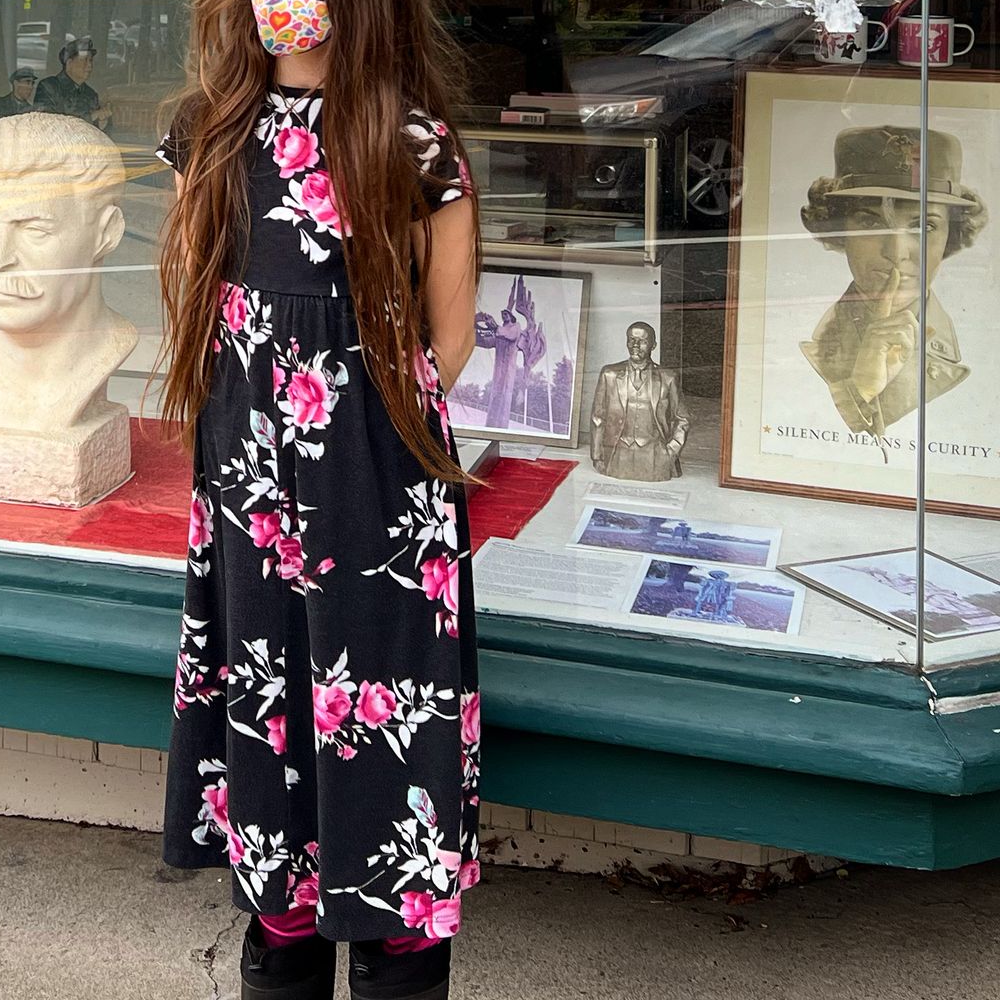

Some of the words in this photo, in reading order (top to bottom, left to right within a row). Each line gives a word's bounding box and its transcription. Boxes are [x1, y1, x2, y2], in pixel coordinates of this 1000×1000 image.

[776, 425, 840, 442] SILENCE
[847, 433, 901, 449] MEANS
[908, 439, 992, 458] SCURITY
